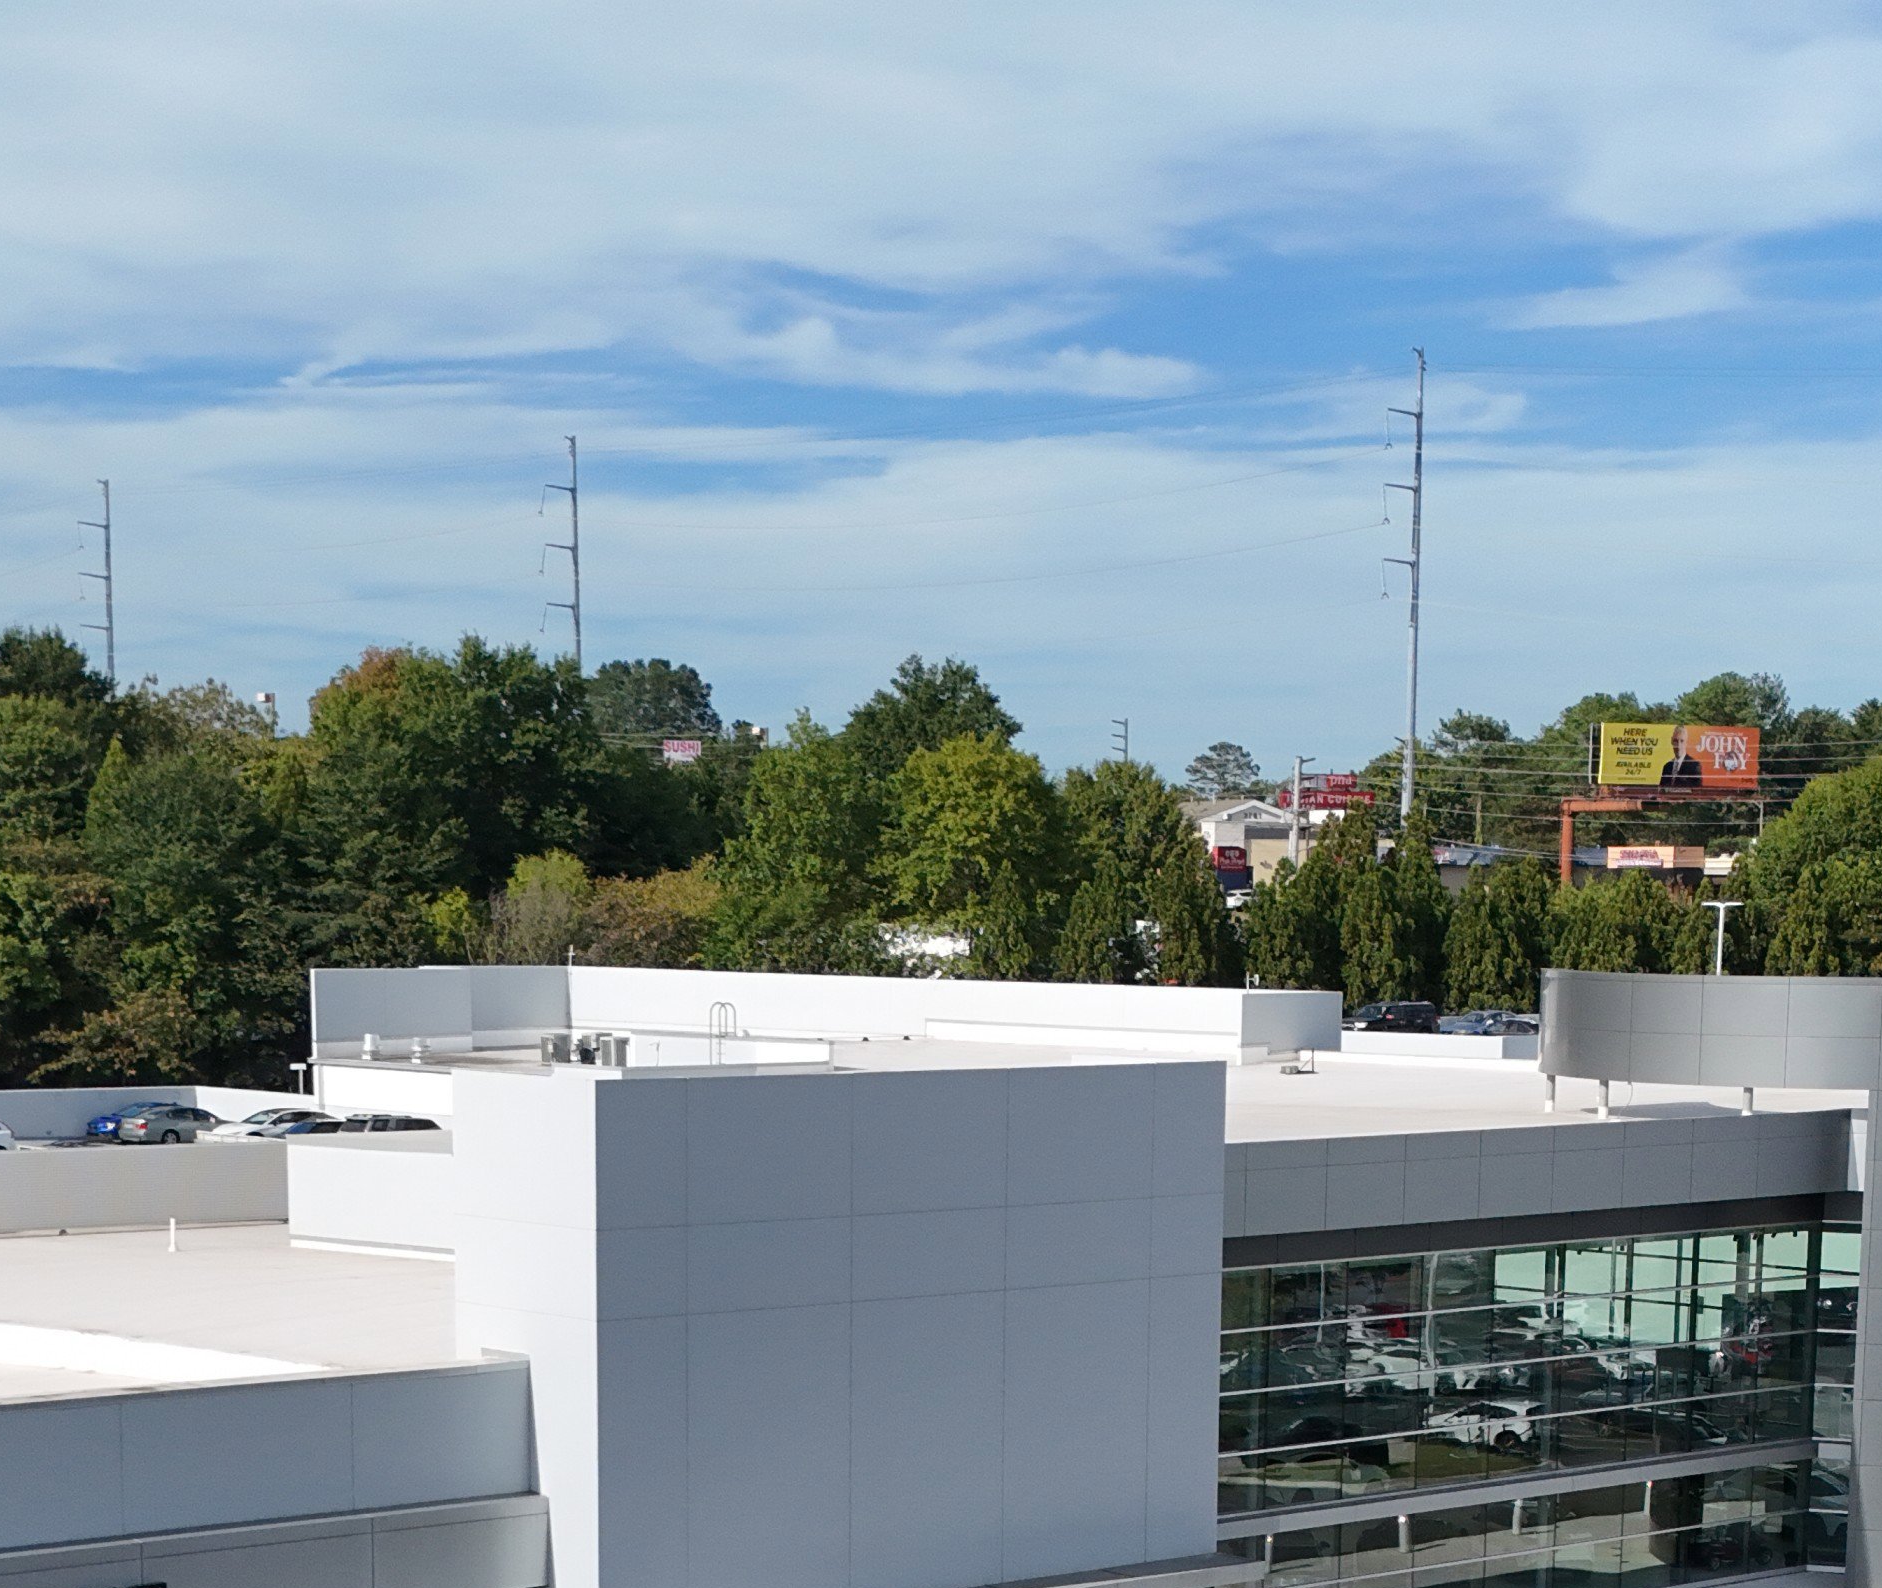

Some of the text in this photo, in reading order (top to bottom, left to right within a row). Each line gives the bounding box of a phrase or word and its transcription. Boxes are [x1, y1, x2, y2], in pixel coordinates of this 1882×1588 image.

[1623, 728, 1648, 736] HERE
[1611, 737, 1659, 746] WHEN YOU
[1696, 735, 1749, 753] JOHN
[1616, 747, 1653, 756] NEED US
